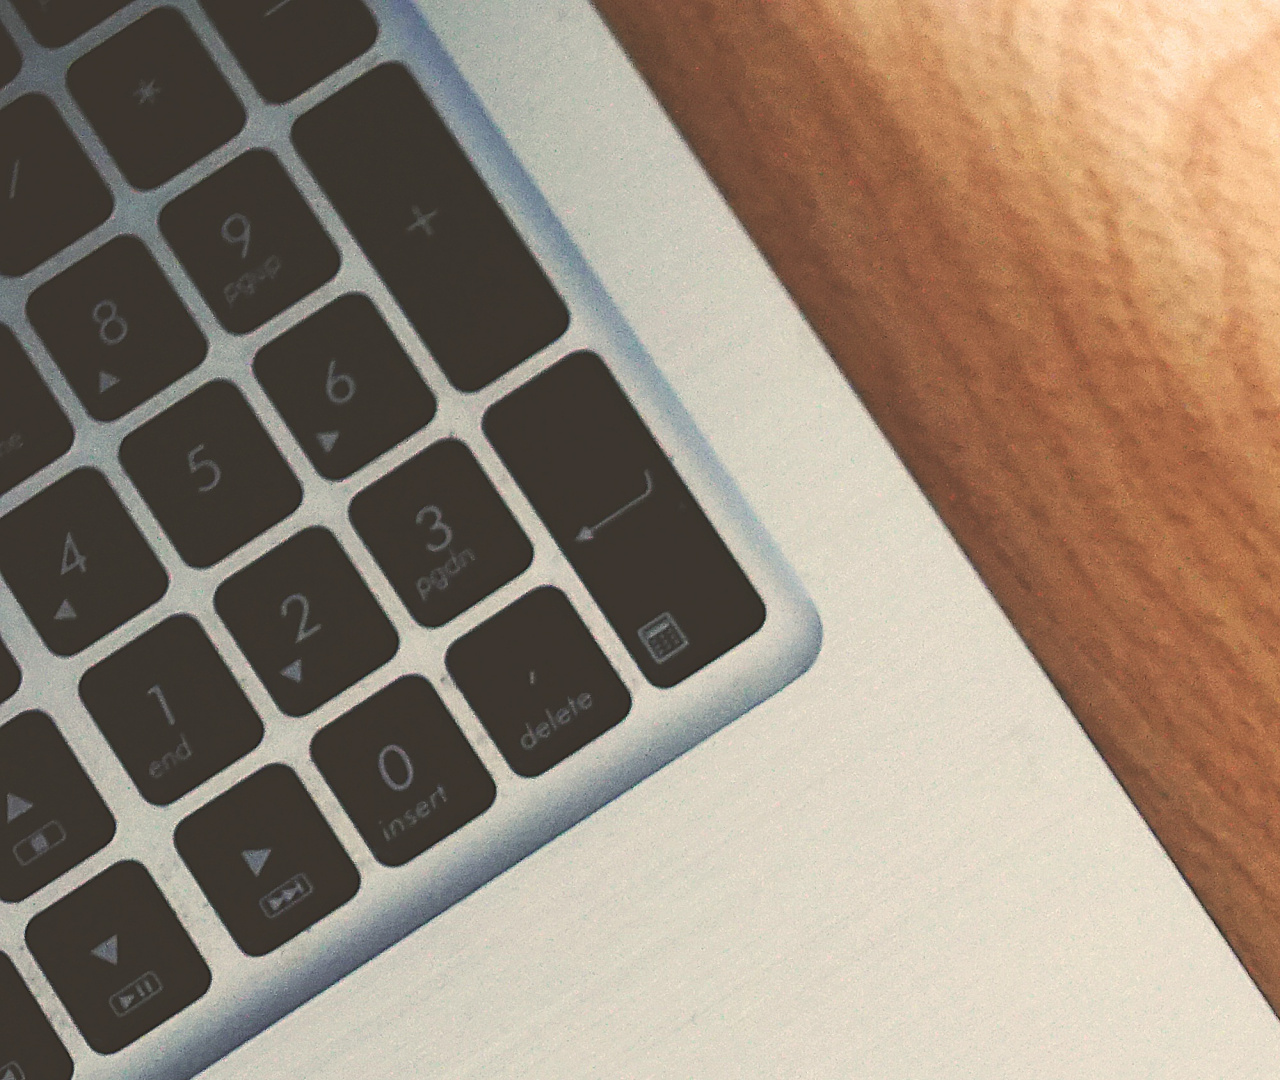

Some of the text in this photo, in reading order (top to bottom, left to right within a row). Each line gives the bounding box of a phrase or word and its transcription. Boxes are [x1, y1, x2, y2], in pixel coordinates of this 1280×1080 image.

[220, 213, 252, 259] 9
[92, 299, 128, 346] 8
[325, 359, 356, 405] 6
[187, 443, 222, 493] 5
[415, 504, 453, 553] 3
[60, 531, 87, 576] 4
[415, 547, 476, 602] pgdn
[280, 593, 322, 643] 2
[146, 684, 176, 726] 1
[519, 690, 594, 751] delete
[148, 733, 193, 780] end
[378, 744, 415, 792] 0
[377, 784, 449, 842] insert
